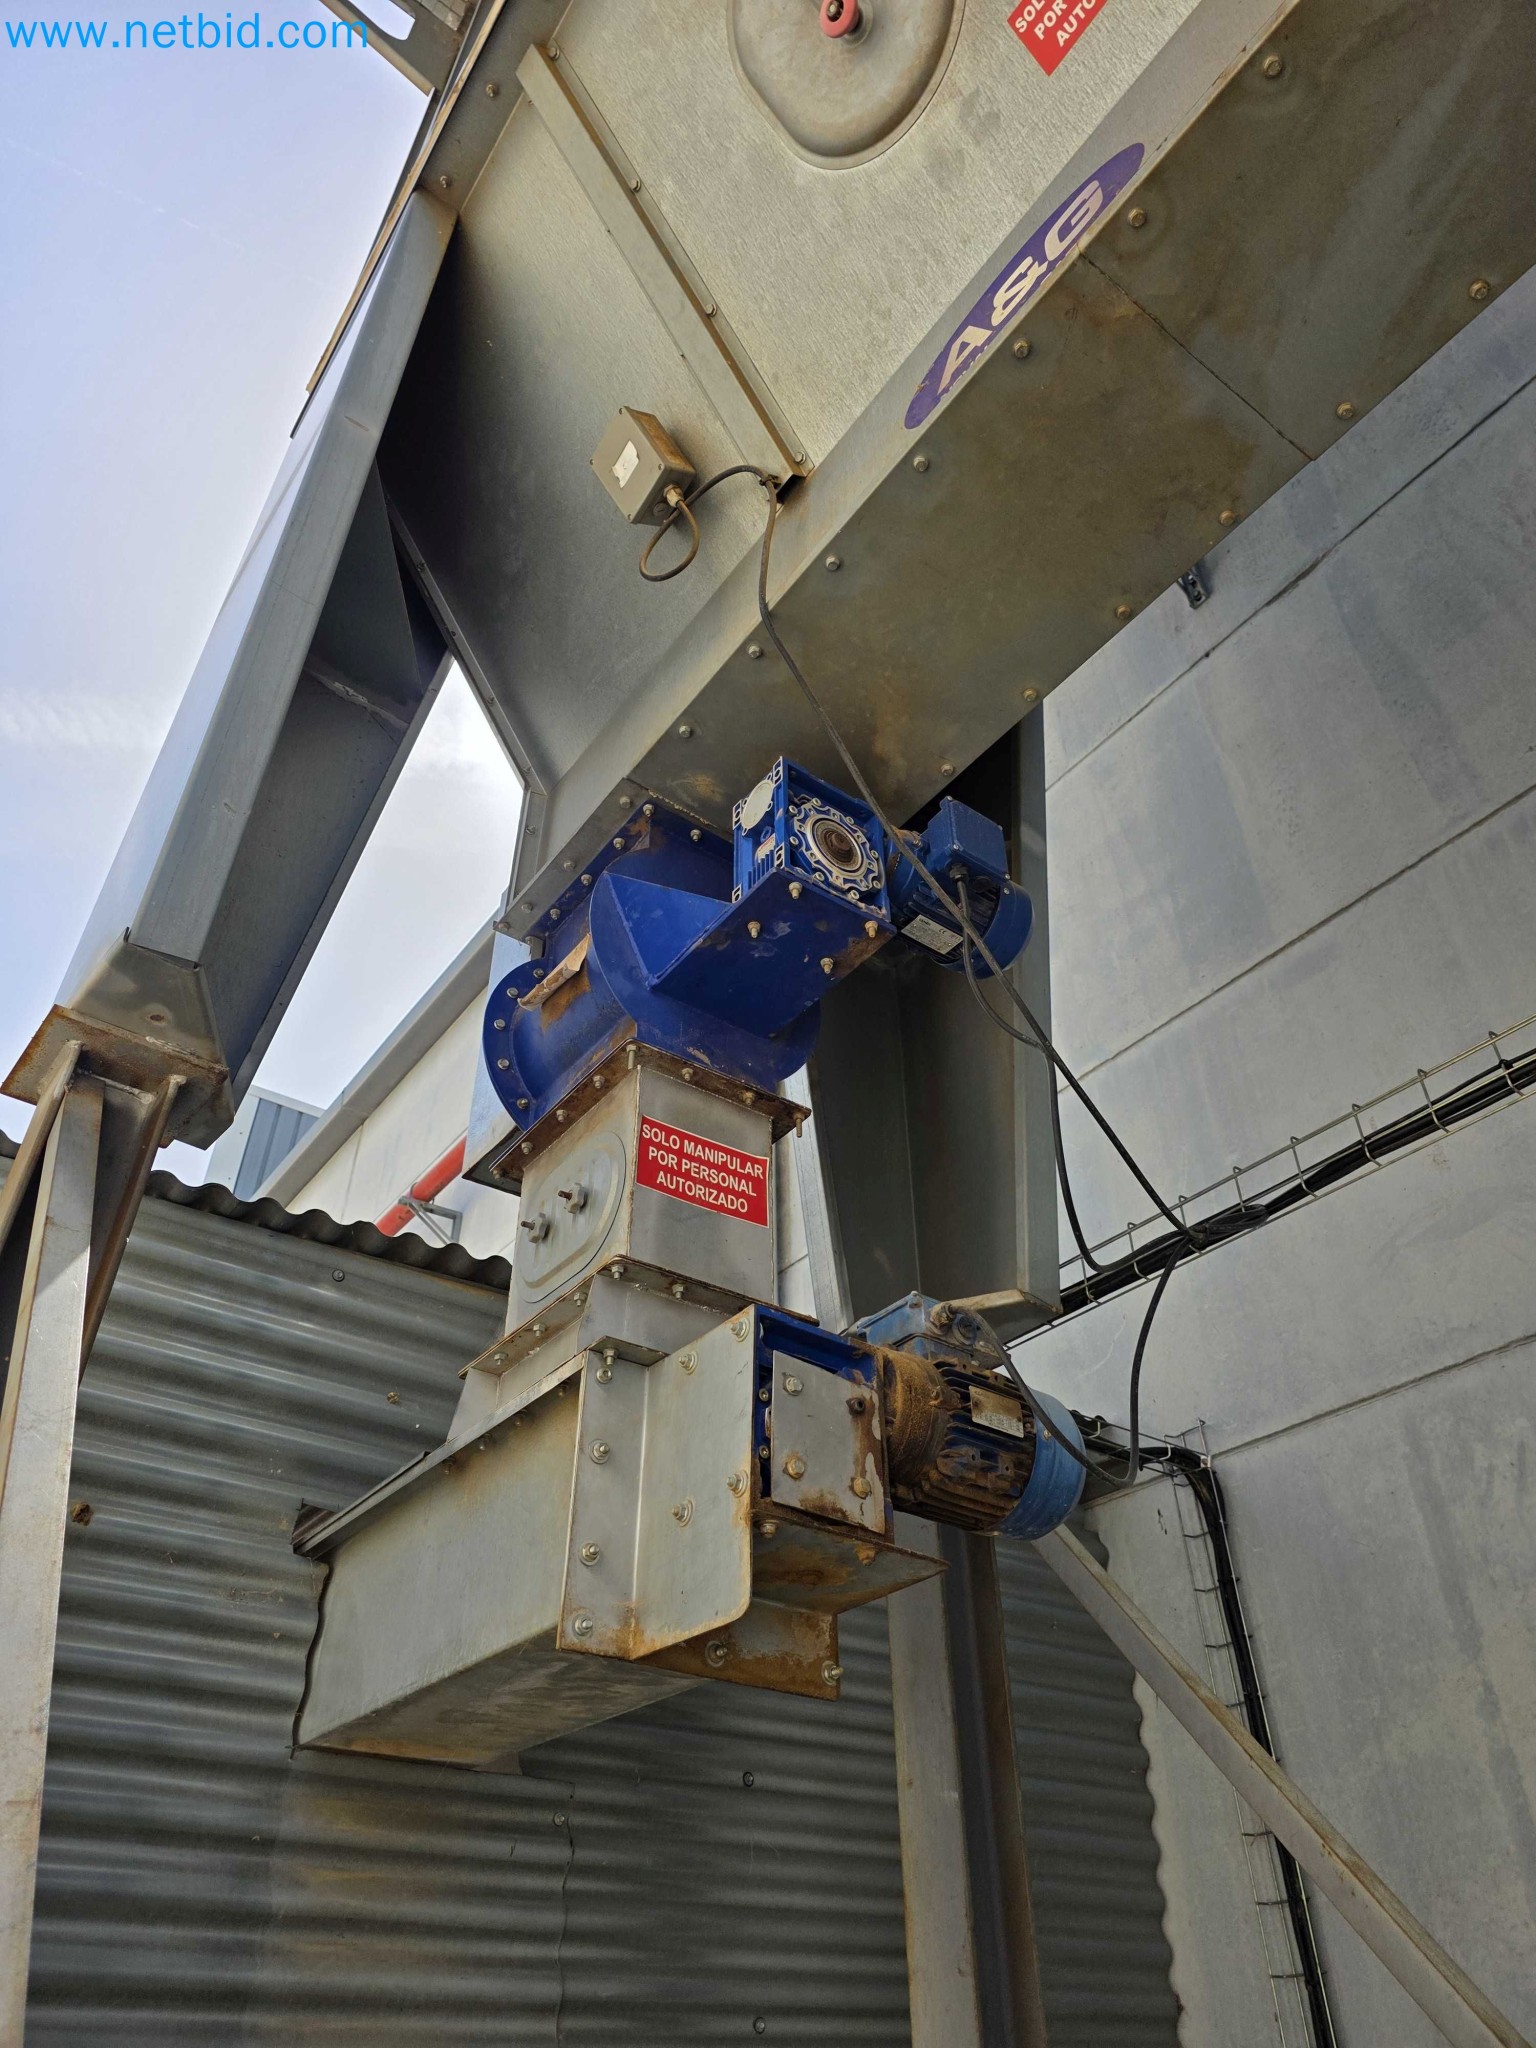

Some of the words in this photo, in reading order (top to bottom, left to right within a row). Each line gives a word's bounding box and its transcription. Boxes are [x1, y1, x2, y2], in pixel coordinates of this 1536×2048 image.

[1034, 0, 1068, 41] POR
[937, 179, 1104, 396] A&G
[641, 1124, 680, 1149] SOLO
[683, 1139, 764, 1180] MANIPULAR
[648, 1146, 678, 1171] POR
[681, 1159, 757, 1197] PERSONAL
[656, 1170, 748, 1213] AUTORIZADO
